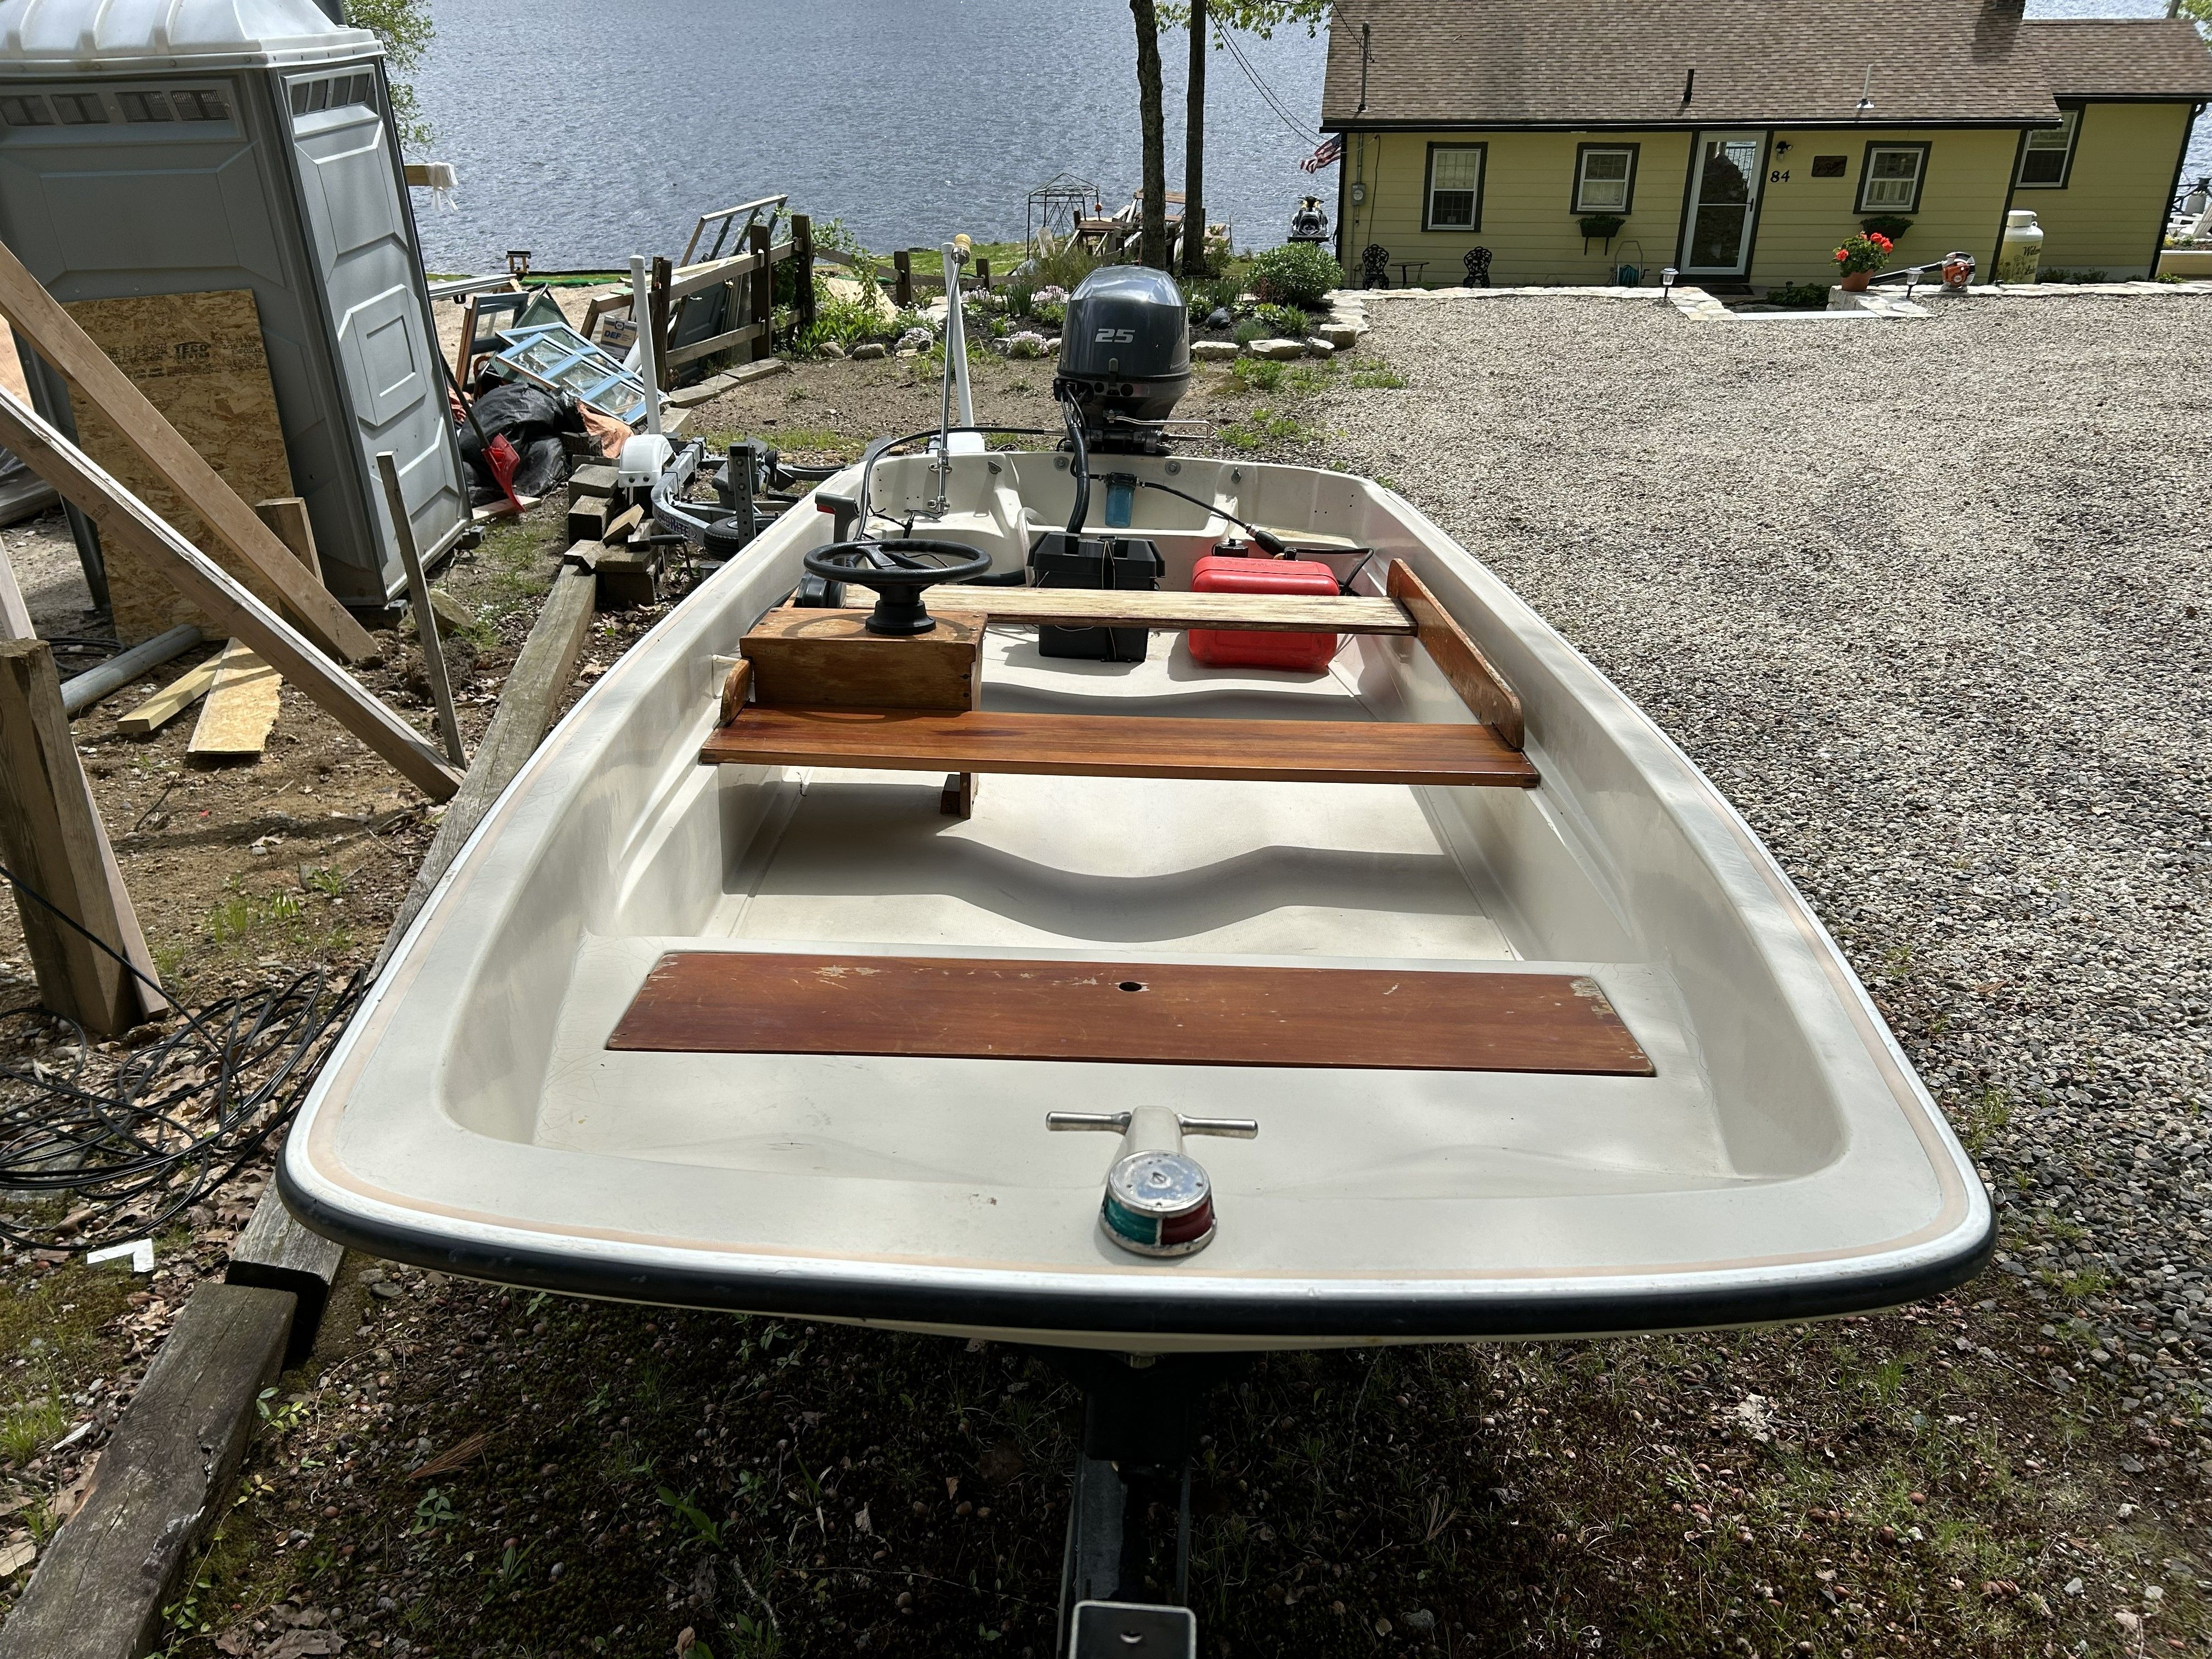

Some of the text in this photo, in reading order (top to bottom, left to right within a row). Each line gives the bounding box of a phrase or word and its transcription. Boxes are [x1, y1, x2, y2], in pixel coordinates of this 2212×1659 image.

[1770, 170, 1790, 183] 84
[604, 330, 622, 340] DEF
[1095, 328, 1135, 343] 25
[174, 343, 210, 354] TECO
